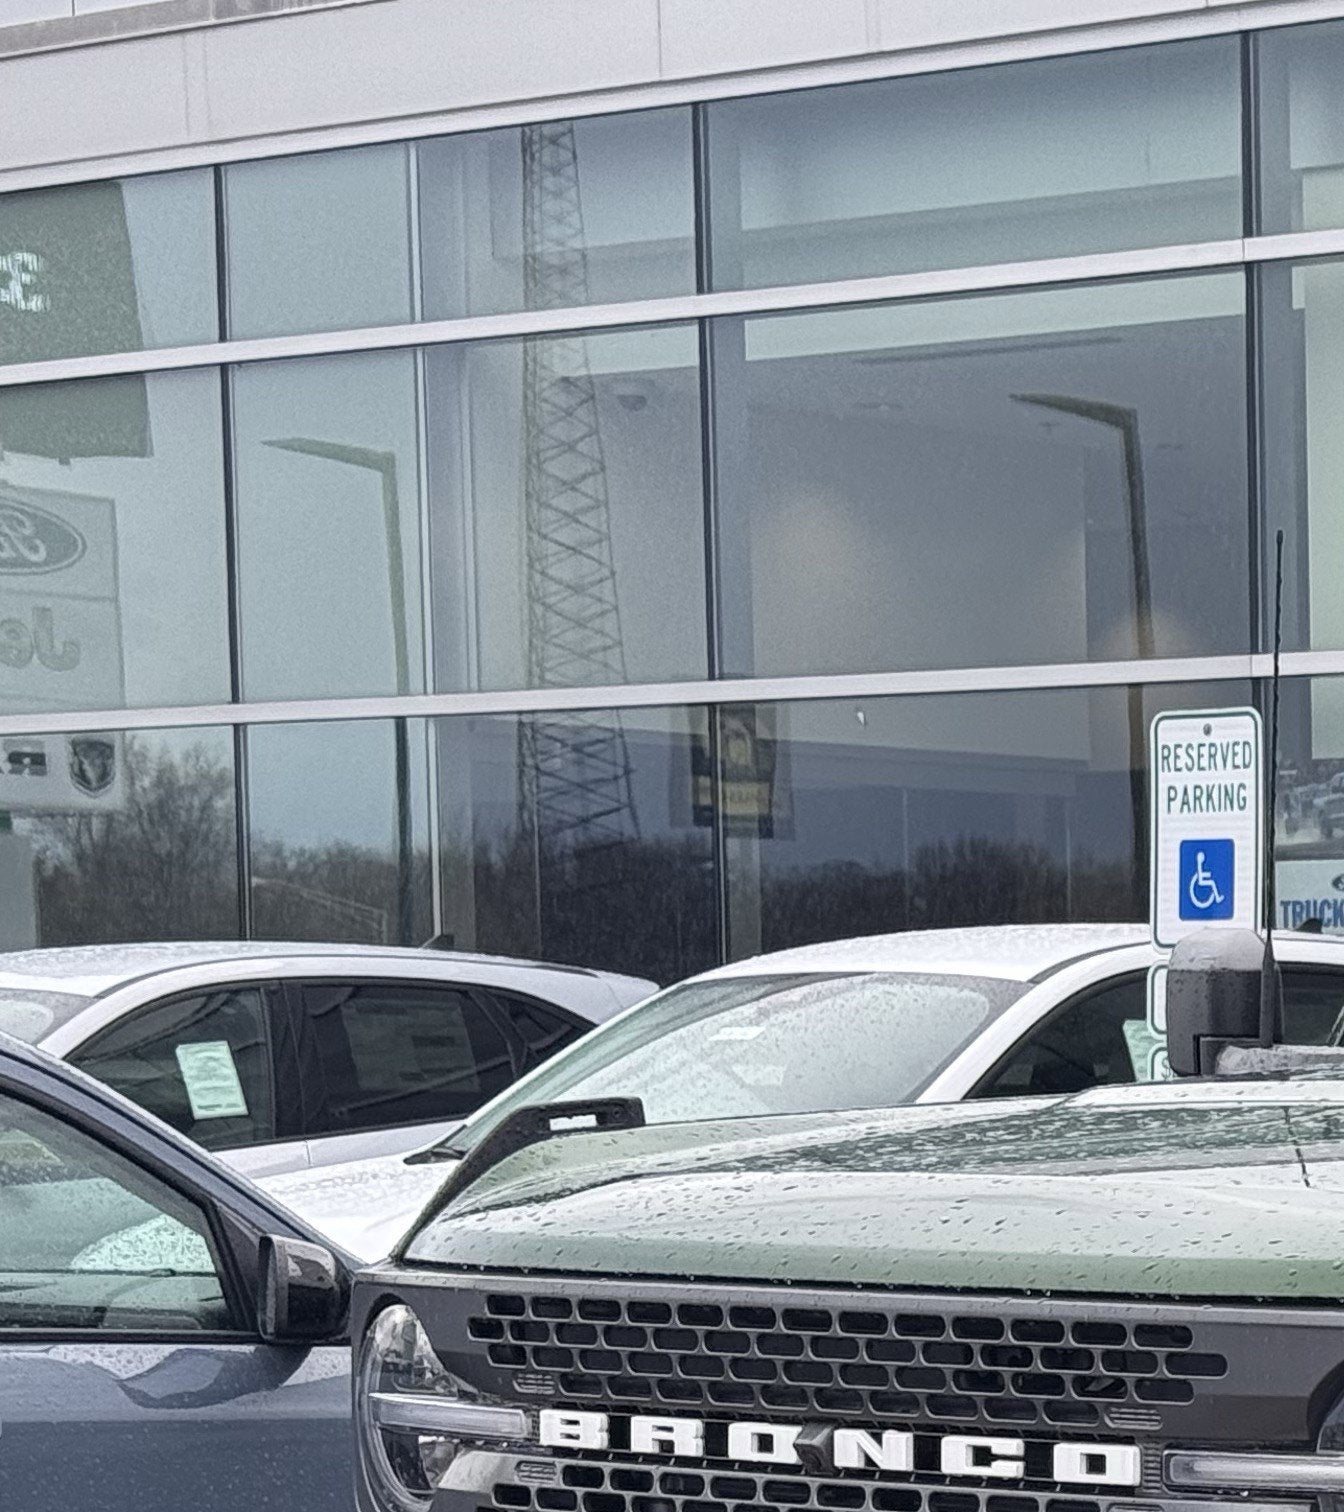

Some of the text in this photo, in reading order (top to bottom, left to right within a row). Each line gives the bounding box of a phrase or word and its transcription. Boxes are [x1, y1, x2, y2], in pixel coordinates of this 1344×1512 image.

[1161, 740, 1252, 772] RESERVED
[1167, 782, 1247, 814] PARKING
[539, 1408, 1140, 1487] BRONCO
